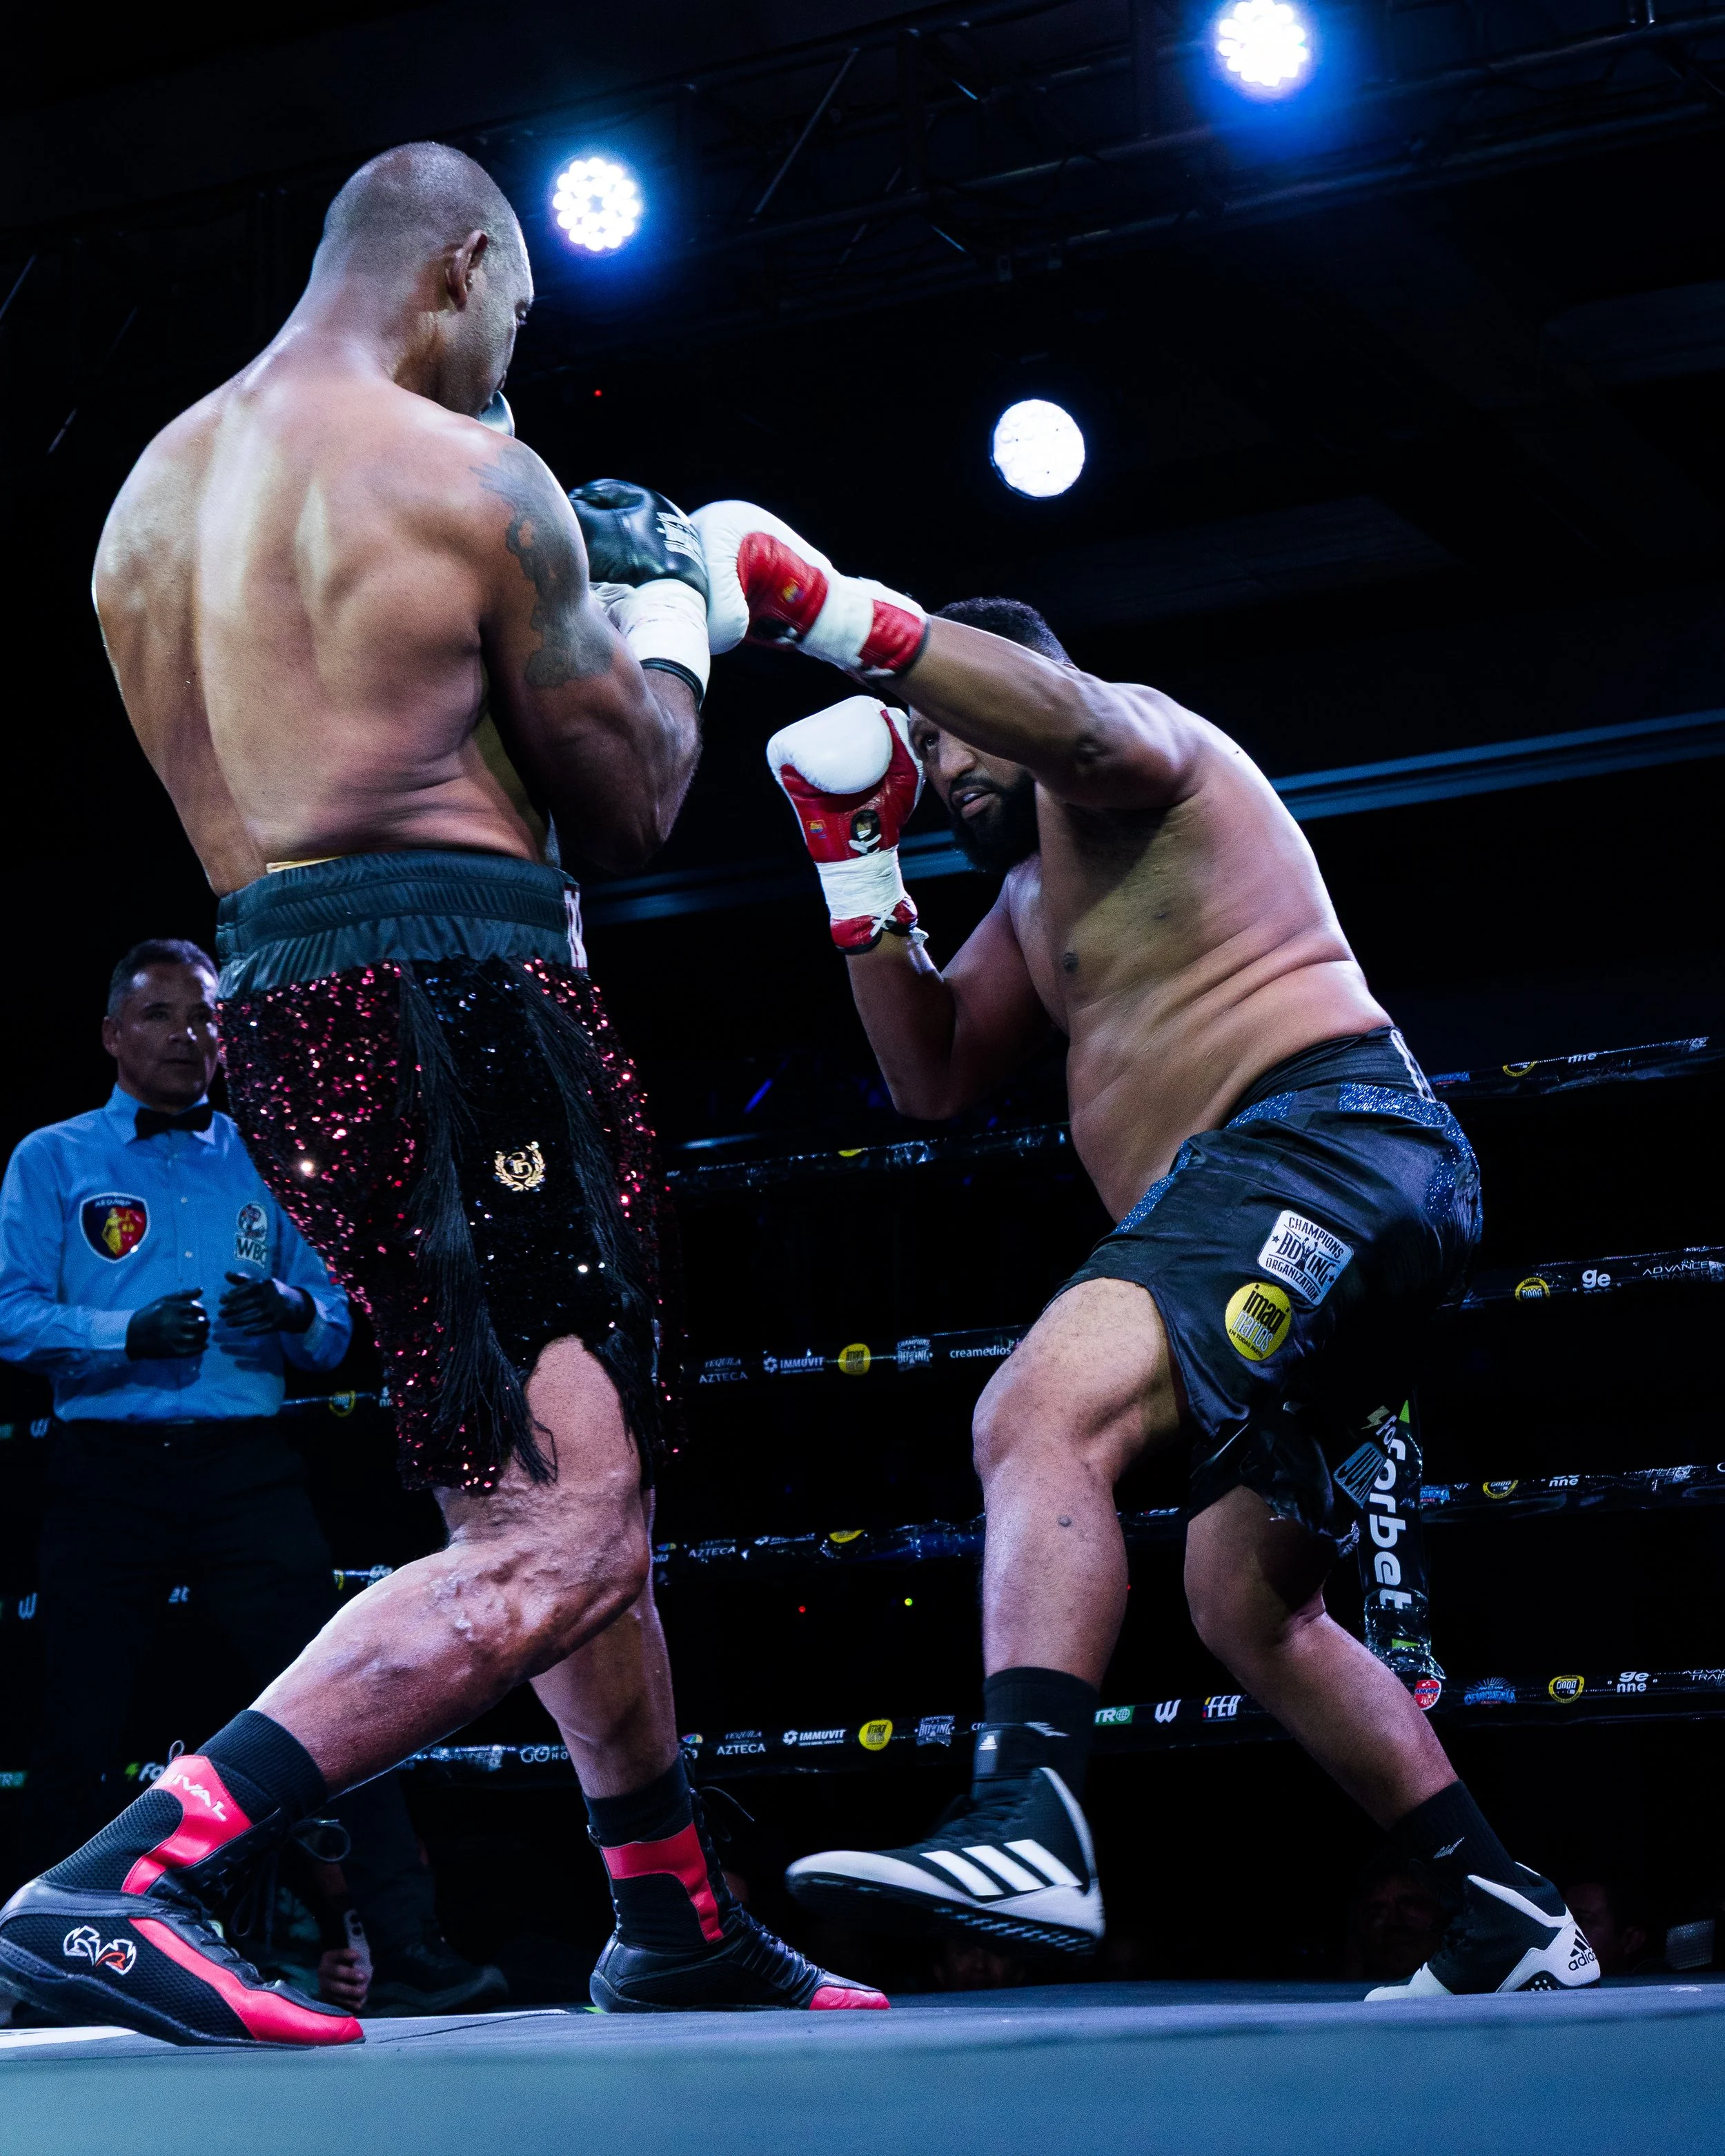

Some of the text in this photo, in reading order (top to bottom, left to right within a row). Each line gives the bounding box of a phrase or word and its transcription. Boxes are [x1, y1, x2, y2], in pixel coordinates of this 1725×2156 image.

[1288, 1216, 1344, 1259] CHAMPIONS
[1275, 1230, 1337, 1287] BOXING
[1265, 1257, 1319, 1302] ORGANIZATION
[1581, 1269, 1611, 1289] ge
[780, 1357, 825, 1369] IMMUVIT
[699, 1372, 749, 1385] AZTECA
[689, 1545, 737, 1559] AZTECA
[1619, 1671, 1650, 1683] ge
[1617, 1683, 1648, 1693] nne
[799, 1728, 847, 1741] IMMUVIT
[716, 1743, 767, 1756] AZTECA
